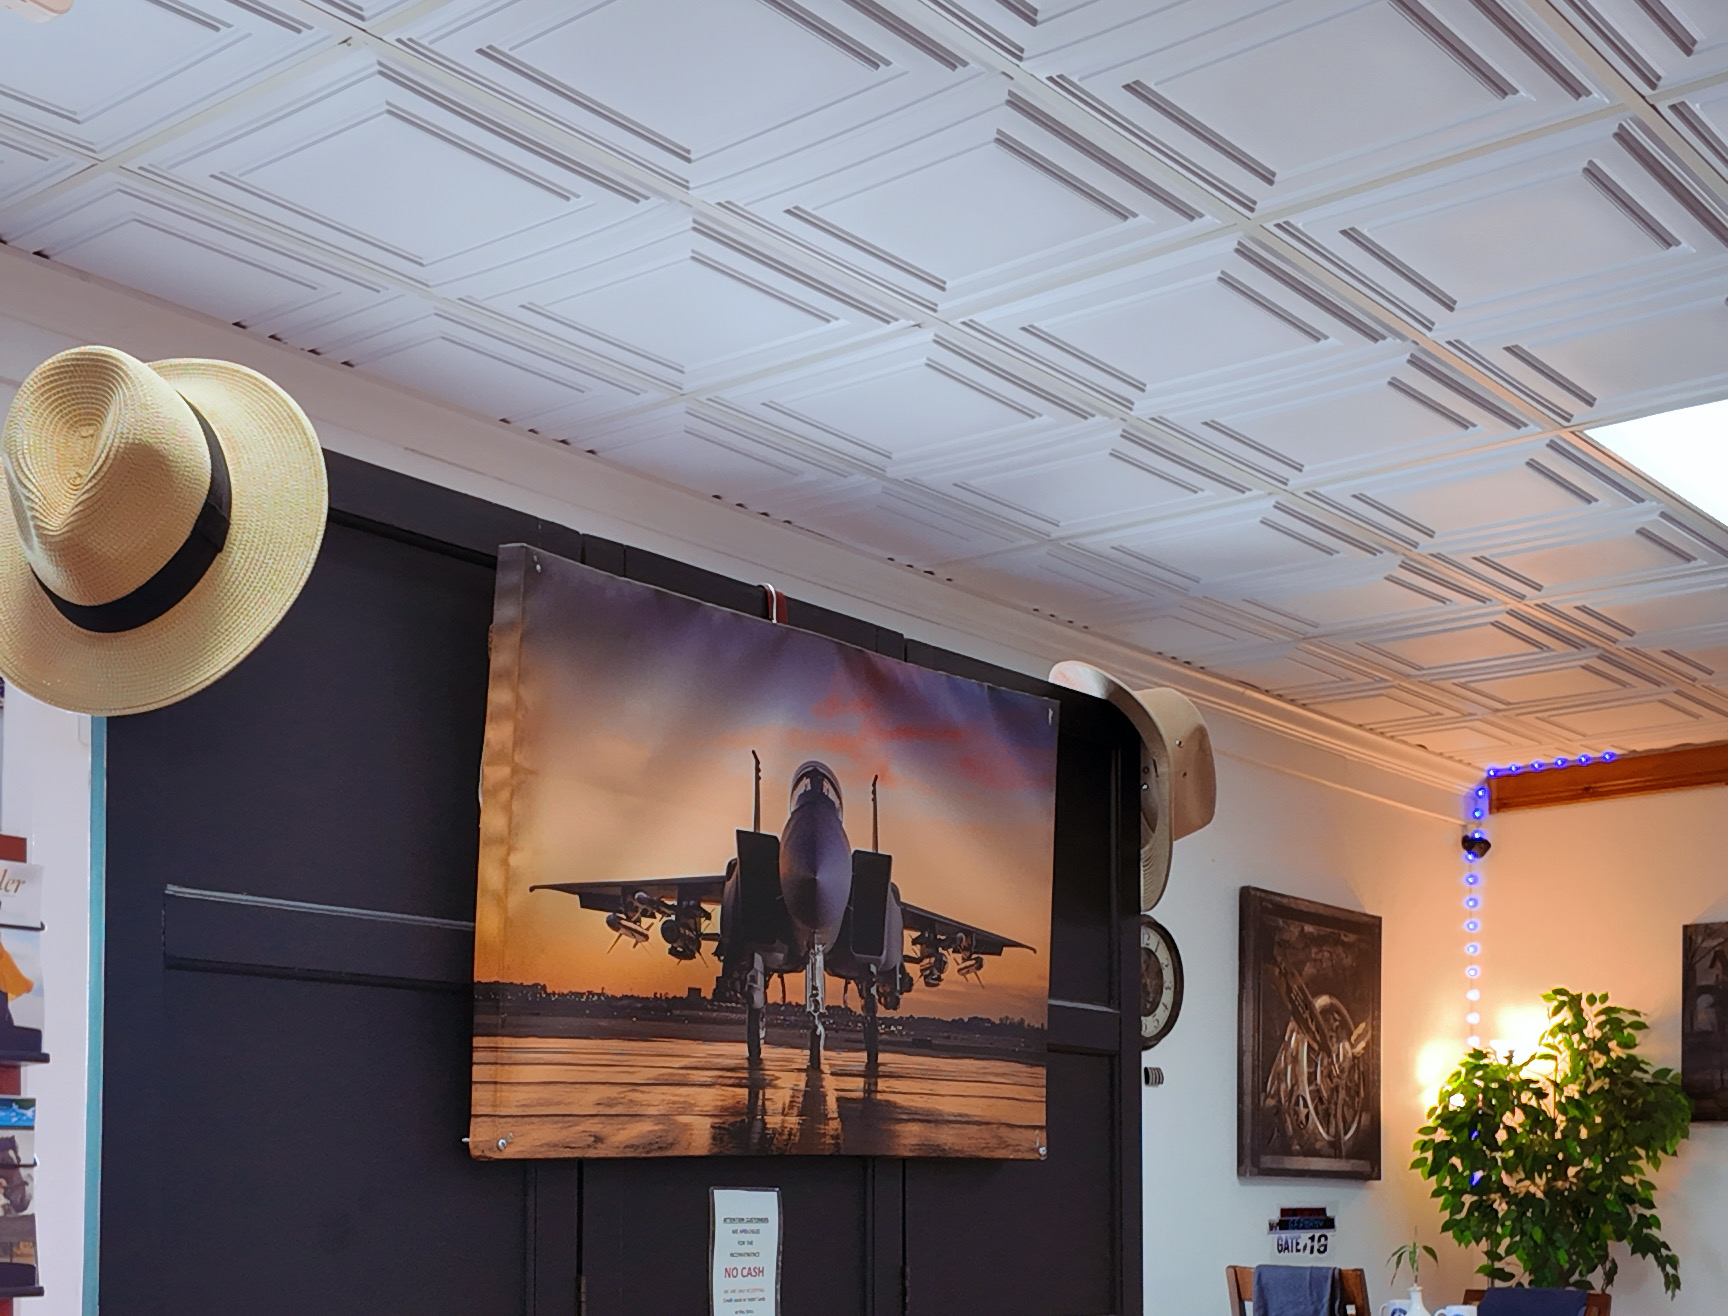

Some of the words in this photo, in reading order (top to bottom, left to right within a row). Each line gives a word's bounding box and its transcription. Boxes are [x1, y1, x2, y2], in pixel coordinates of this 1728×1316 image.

[1277, 1234, 1301, 1253] GATE
[724, 1267, 738, 1278] NO
[741, 1266, 764, 1278] CASH
